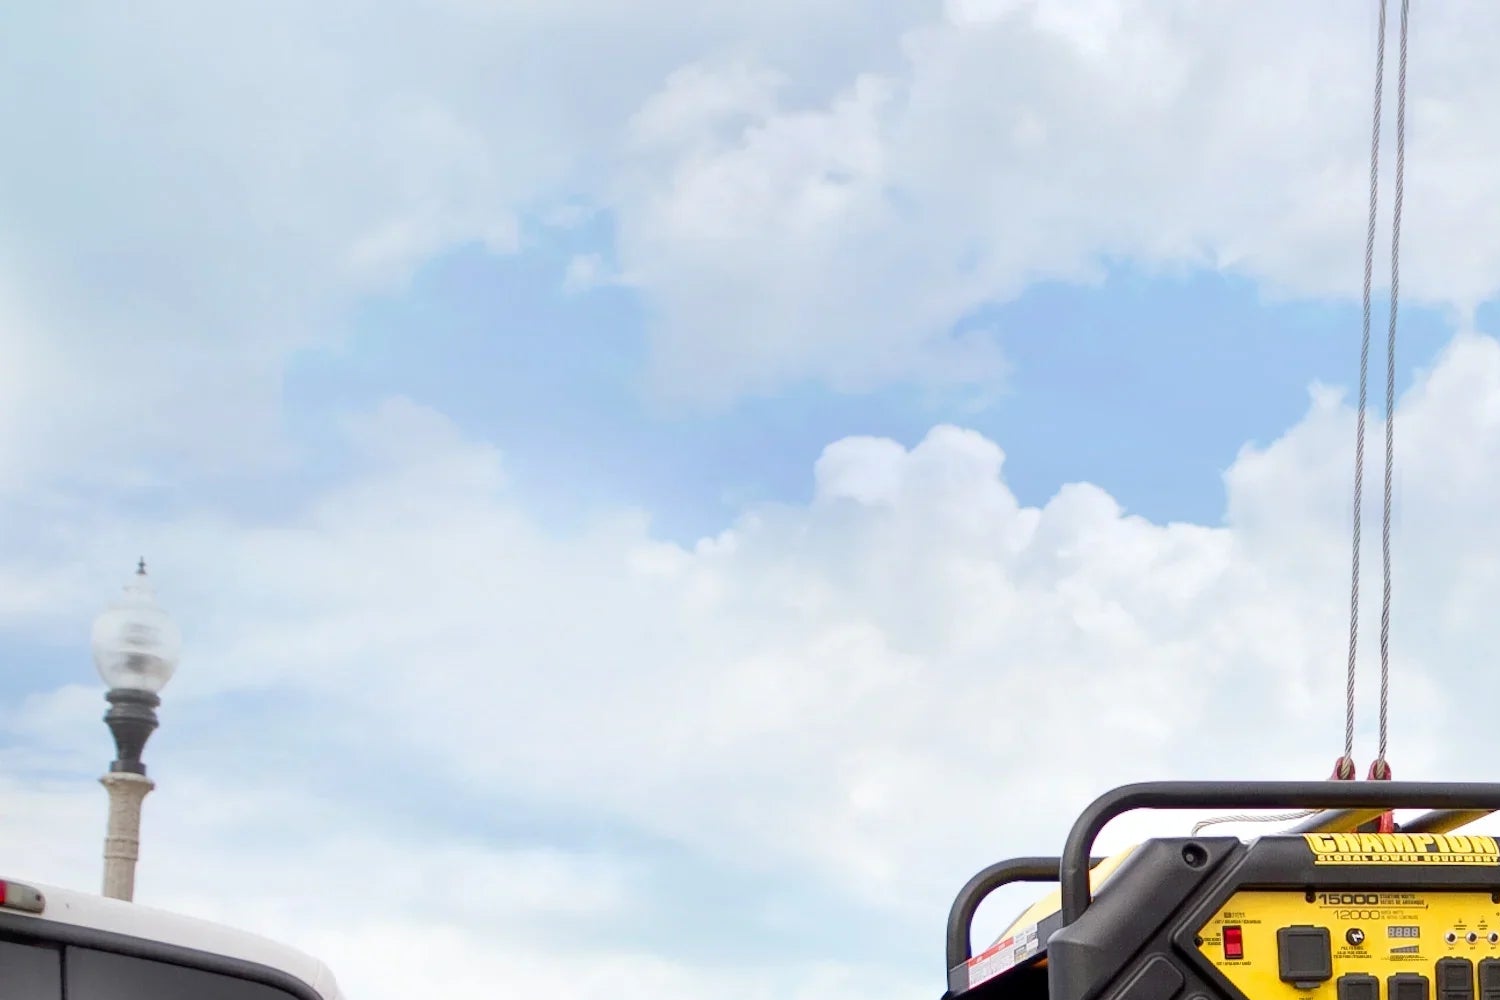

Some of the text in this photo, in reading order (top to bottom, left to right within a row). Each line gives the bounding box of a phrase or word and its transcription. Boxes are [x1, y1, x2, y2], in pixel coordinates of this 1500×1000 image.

[1310, 832, 1498, 854] CHAMPION
[1424, 855, 1499, 863] EQUIPMENT
[1318, 894, 1379, 905] 15000
[1333, 910, 1381, 920] 12000
